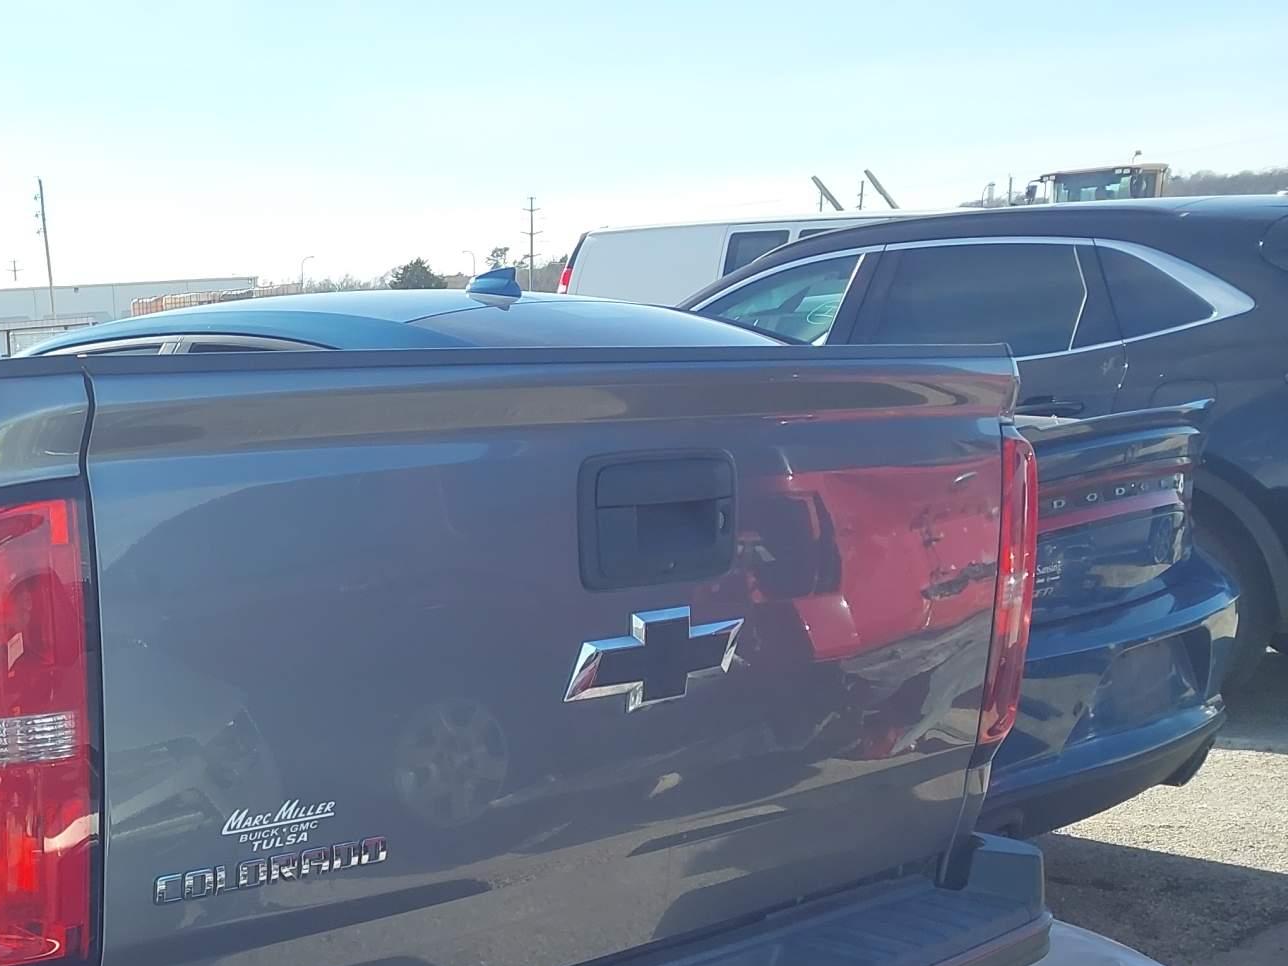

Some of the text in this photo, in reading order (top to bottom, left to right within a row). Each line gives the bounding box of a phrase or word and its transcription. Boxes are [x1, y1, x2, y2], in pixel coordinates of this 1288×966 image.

[222, 799, 336, 834] MARC MILLER
[239, 827, 280, 843] BUICK
[290, 820, 319, 833] GMC
[252, 832, 309, 852] TULSA
[154, 836, 388, 905] COLORADO
